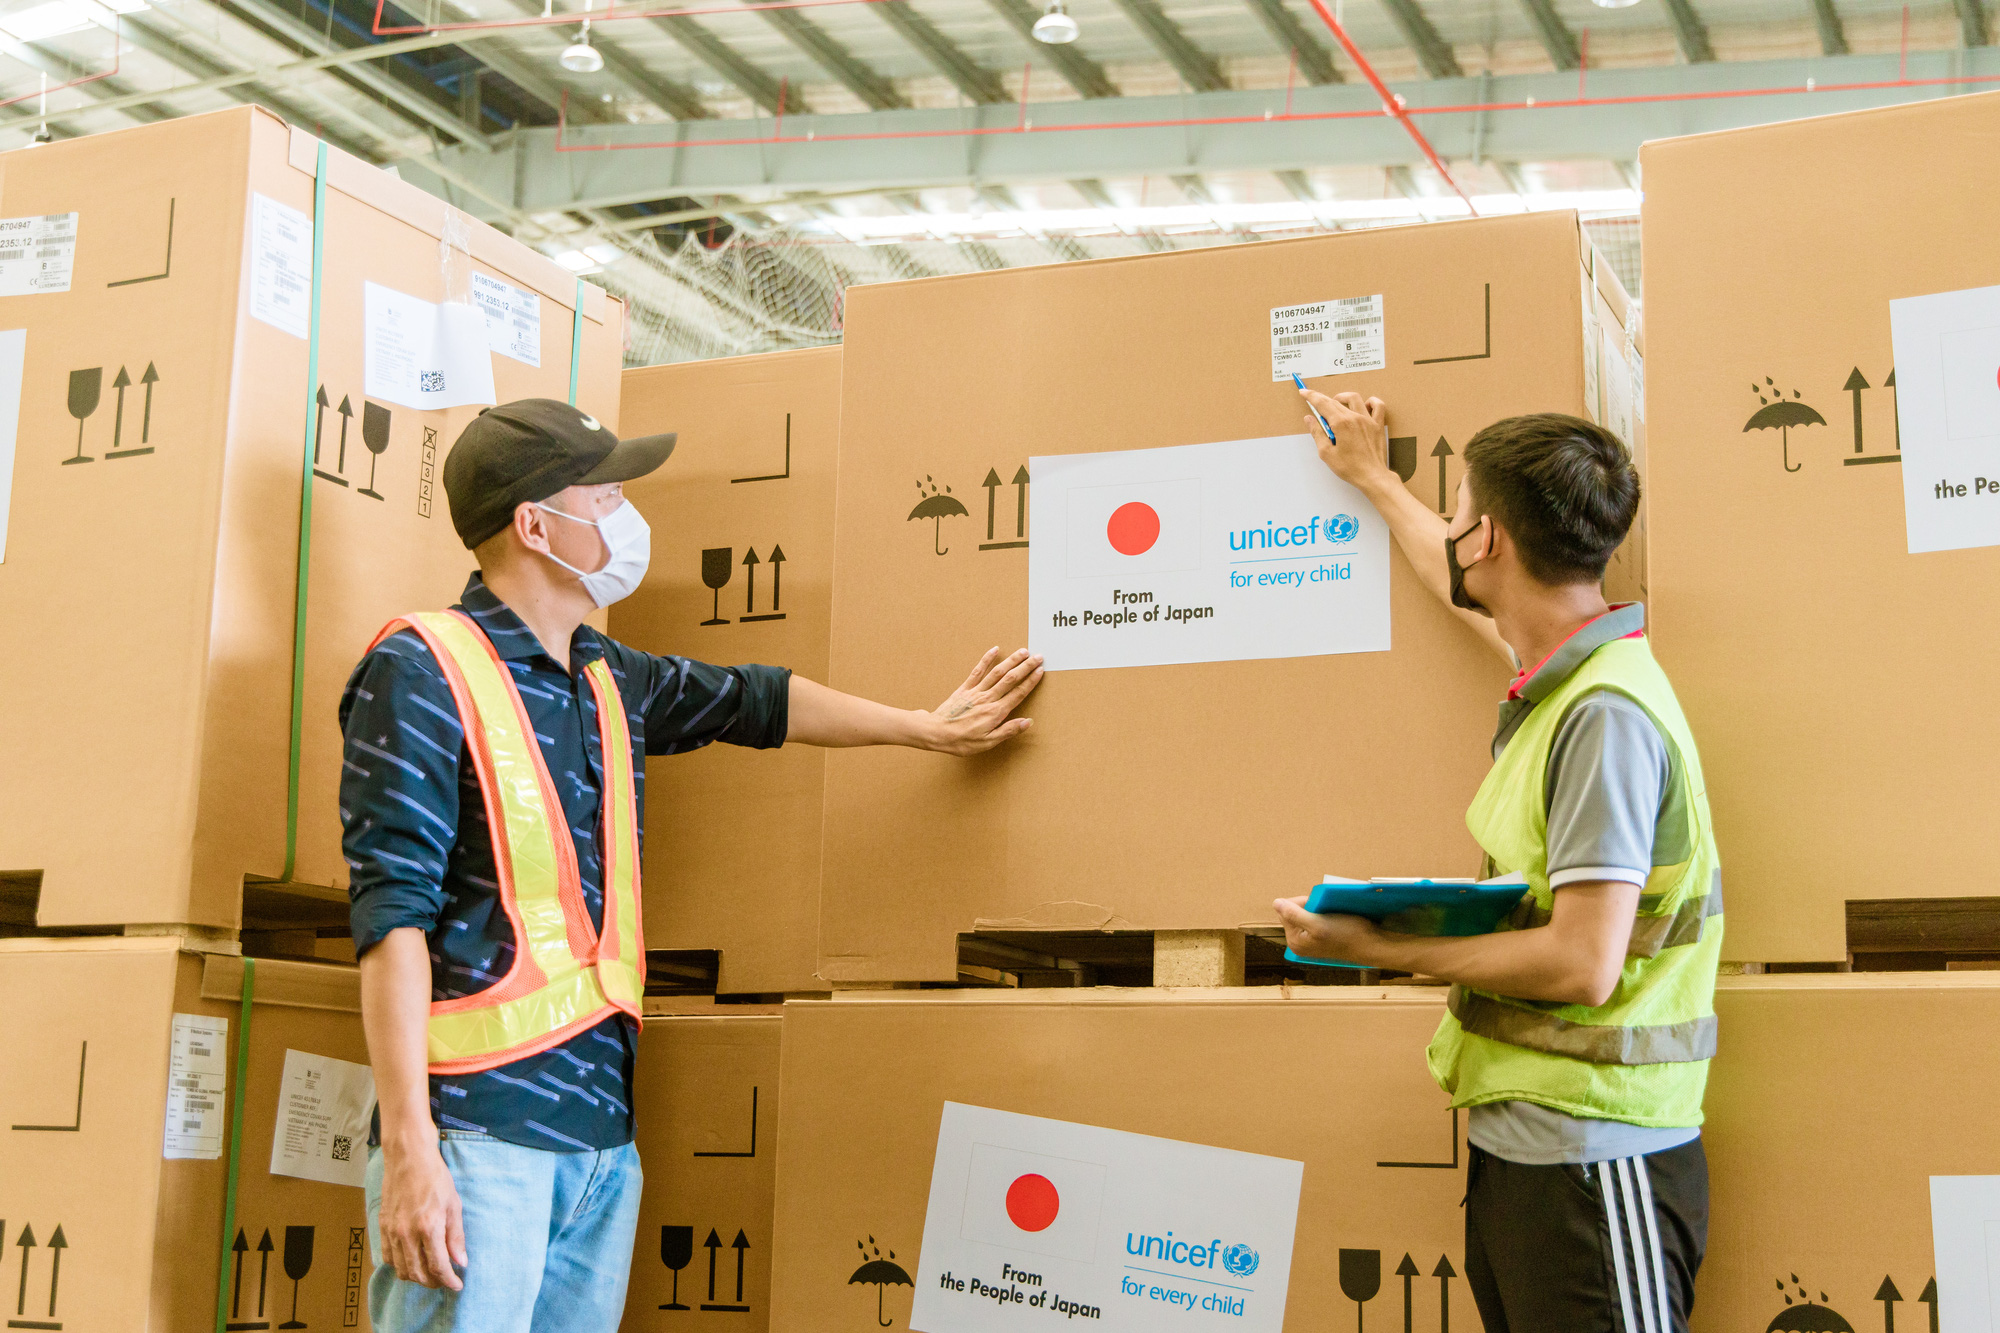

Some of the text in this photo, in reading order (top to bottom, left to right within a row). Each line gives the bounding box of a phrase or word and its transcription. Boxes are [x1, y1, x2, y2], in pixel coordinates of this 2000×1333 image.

[1275, 305, 1325, 319] 9106704947
[1273, 321, 1329, 335] 991.2353.12
[1346, 360, 1381, 368] LUXEMBOURG
[1934, 479, 1967, 500] the
[1230, 516, 1320, 551] unicef
[1230, 563, 1351, 588] for every child
[1113, 590, 1153, 604] From
[1053, 604, 1214, 628] the People of Japan
[1126, 1231, 1221, 1269] unicef
[1002, 1263, 1042, 1286] From
[940, 1272, 1100, 1319] the People of Japan
[1121, 1276, 1244, 1317] for every child
